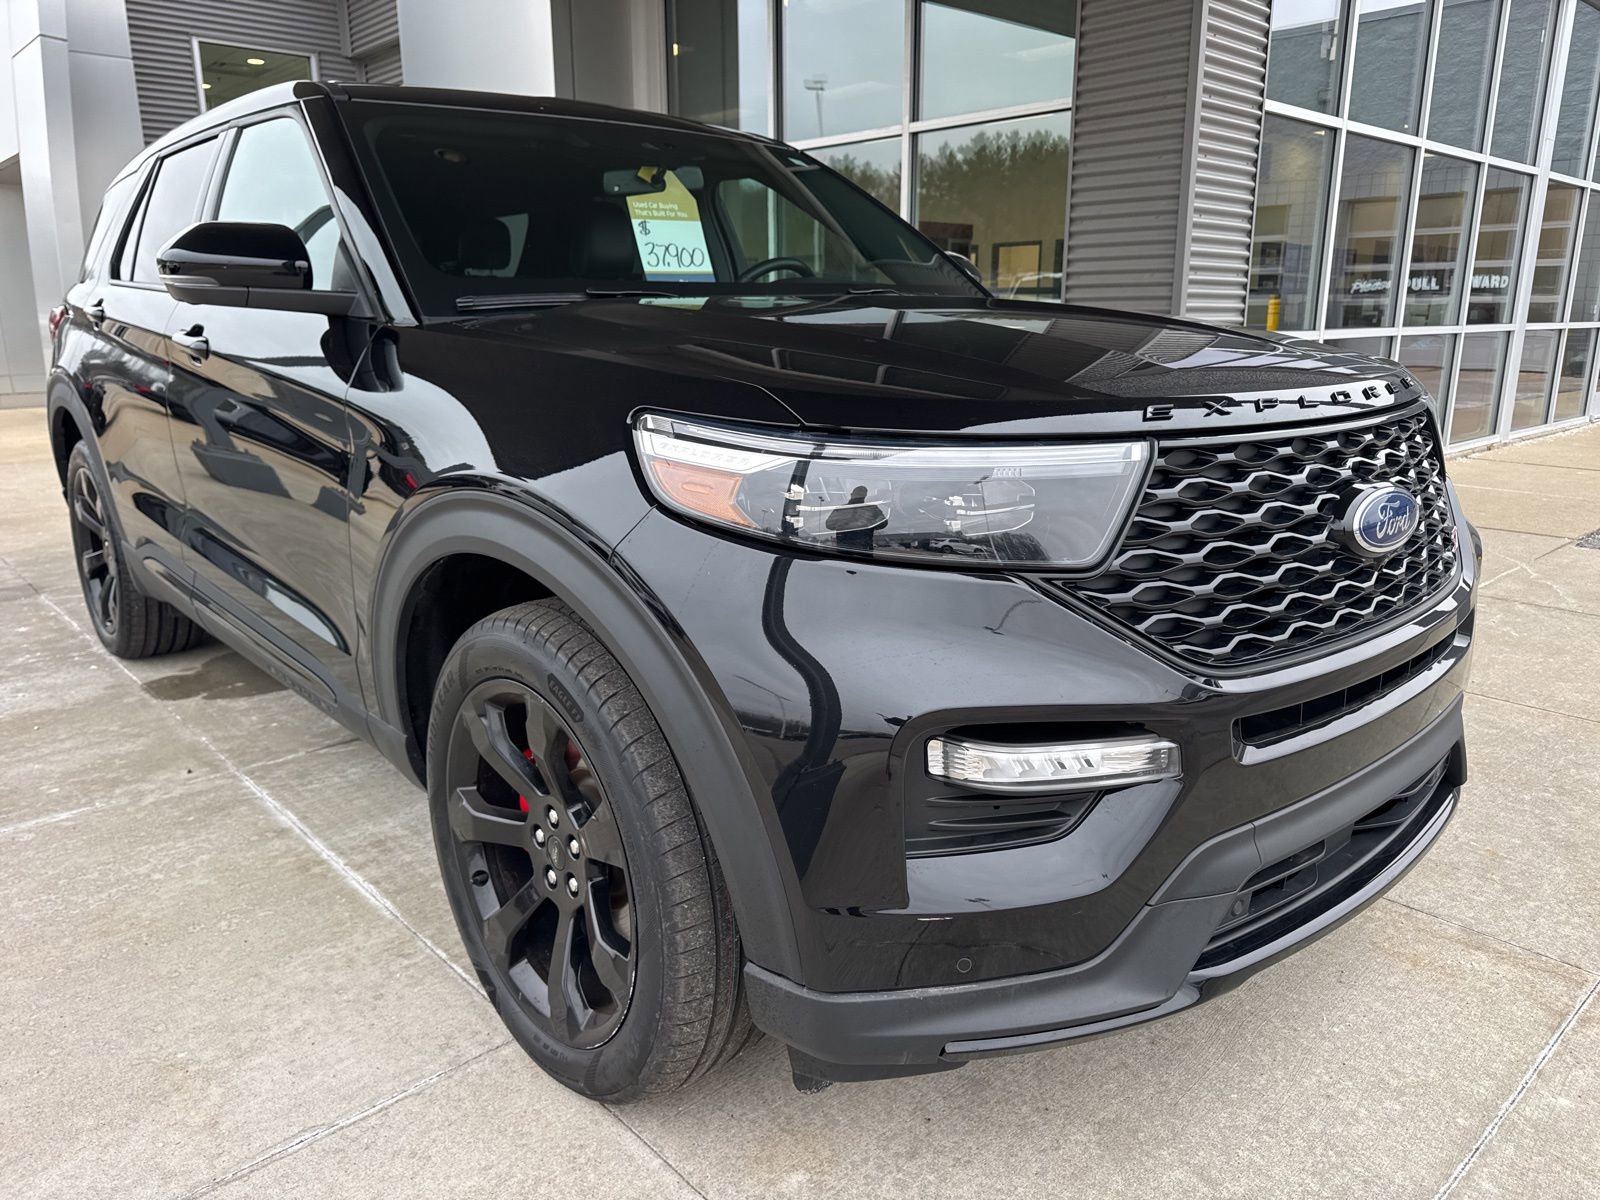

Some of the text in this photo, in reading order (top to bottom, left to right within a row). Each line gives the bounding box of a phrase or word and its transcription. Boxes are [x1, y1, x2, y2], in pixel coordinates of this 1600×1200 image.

[632, 201, 678, 211] Used Car Buying
[634, 209, 652, 217] That's
[652, 209, 666, 217] Built
[638, 220, 651, 236] $
[1471, 275, 1509, 289] WARD
[1142, 375, 1415, 423] EXPLORER
[1376, 500, 1411, 540] Ford
